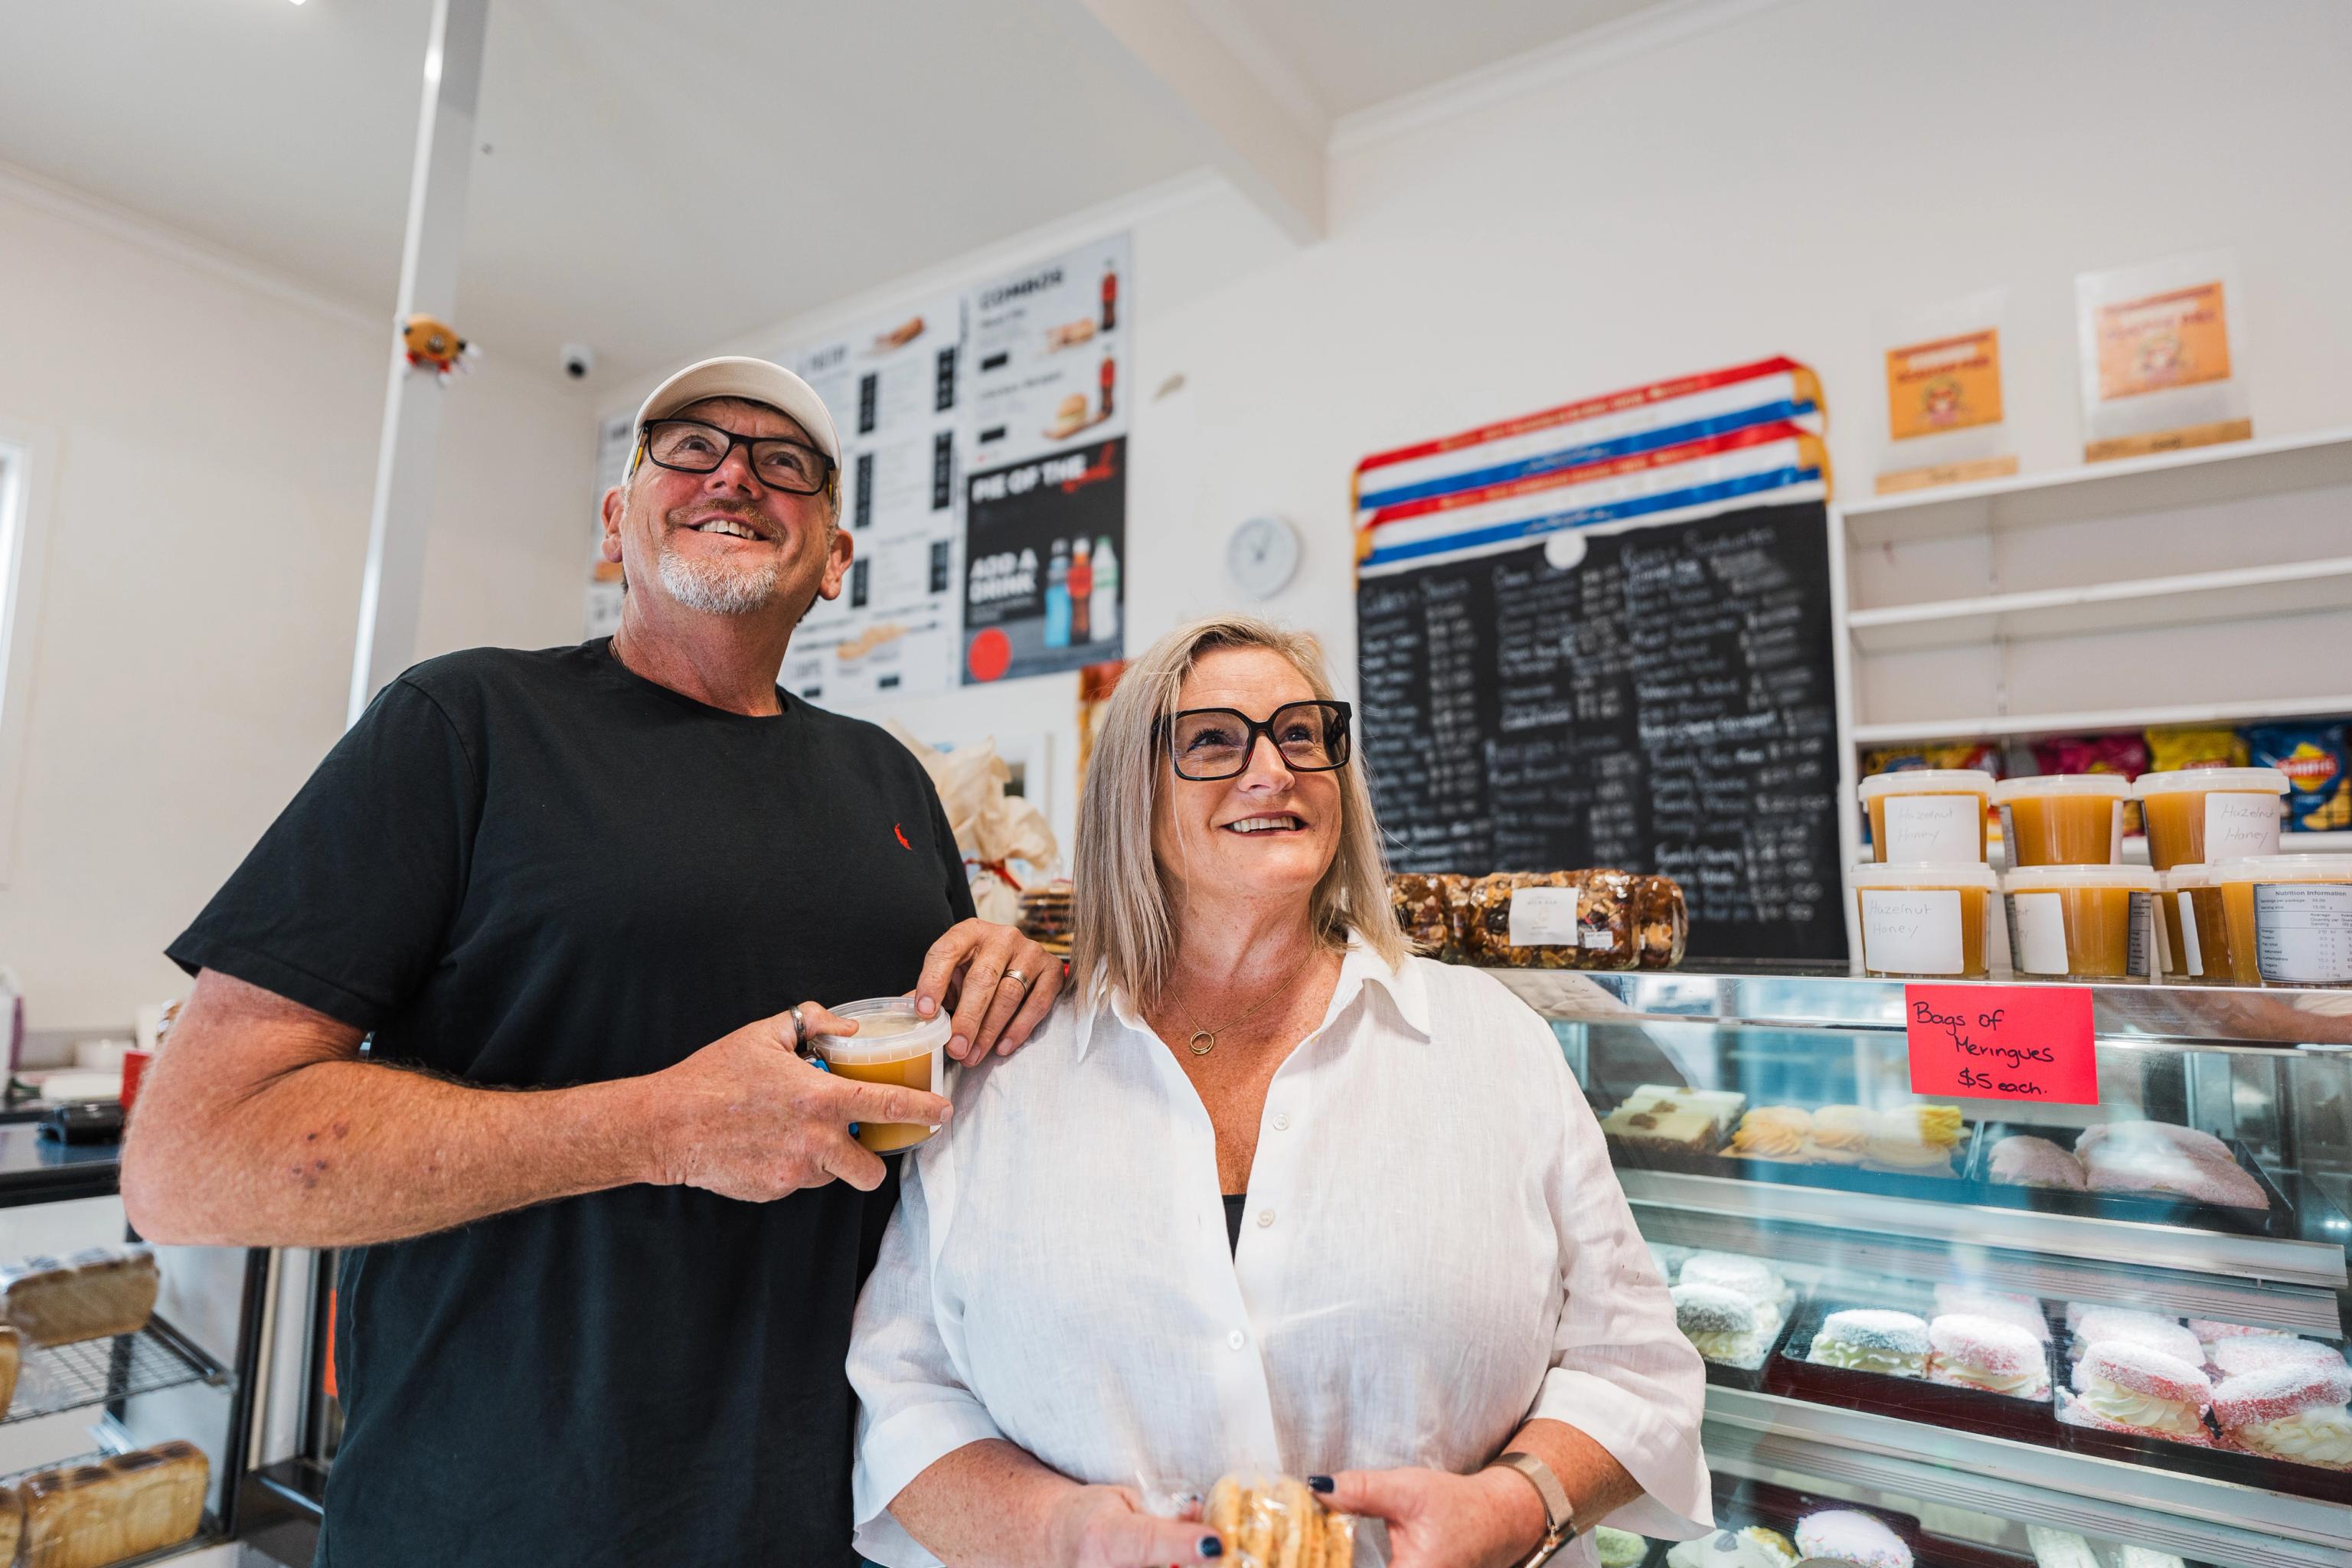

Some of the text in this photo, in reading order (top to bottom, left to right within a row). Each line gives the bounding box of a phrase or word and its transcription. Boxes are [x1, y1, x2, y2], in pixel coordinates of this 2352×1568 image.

[972, 473, 1006, 503] PIE
[1007, 466, 1040, 494] OF
[1042, 454, 1087, 486] THE
[970, 552, 1018, 579] ADD
[1019, 547, 1038, 570] A
[969, 572, 1037, 604] DRINK
[1898, 806, 1954, 821] Hazelnut
[1897, 826, 1940, 845] Honey
[2224, 827, 2268, 848] Honey
[1869, 900, 1933, 915] Hazelnut
[1873, 923, 1919, 939] Honey
[1913, 1001, 2004, 1035] Bags of
[1954, 1035, 2054, 1068] Meringues
[1958, 1067, 2047, 1095] $5 each.
